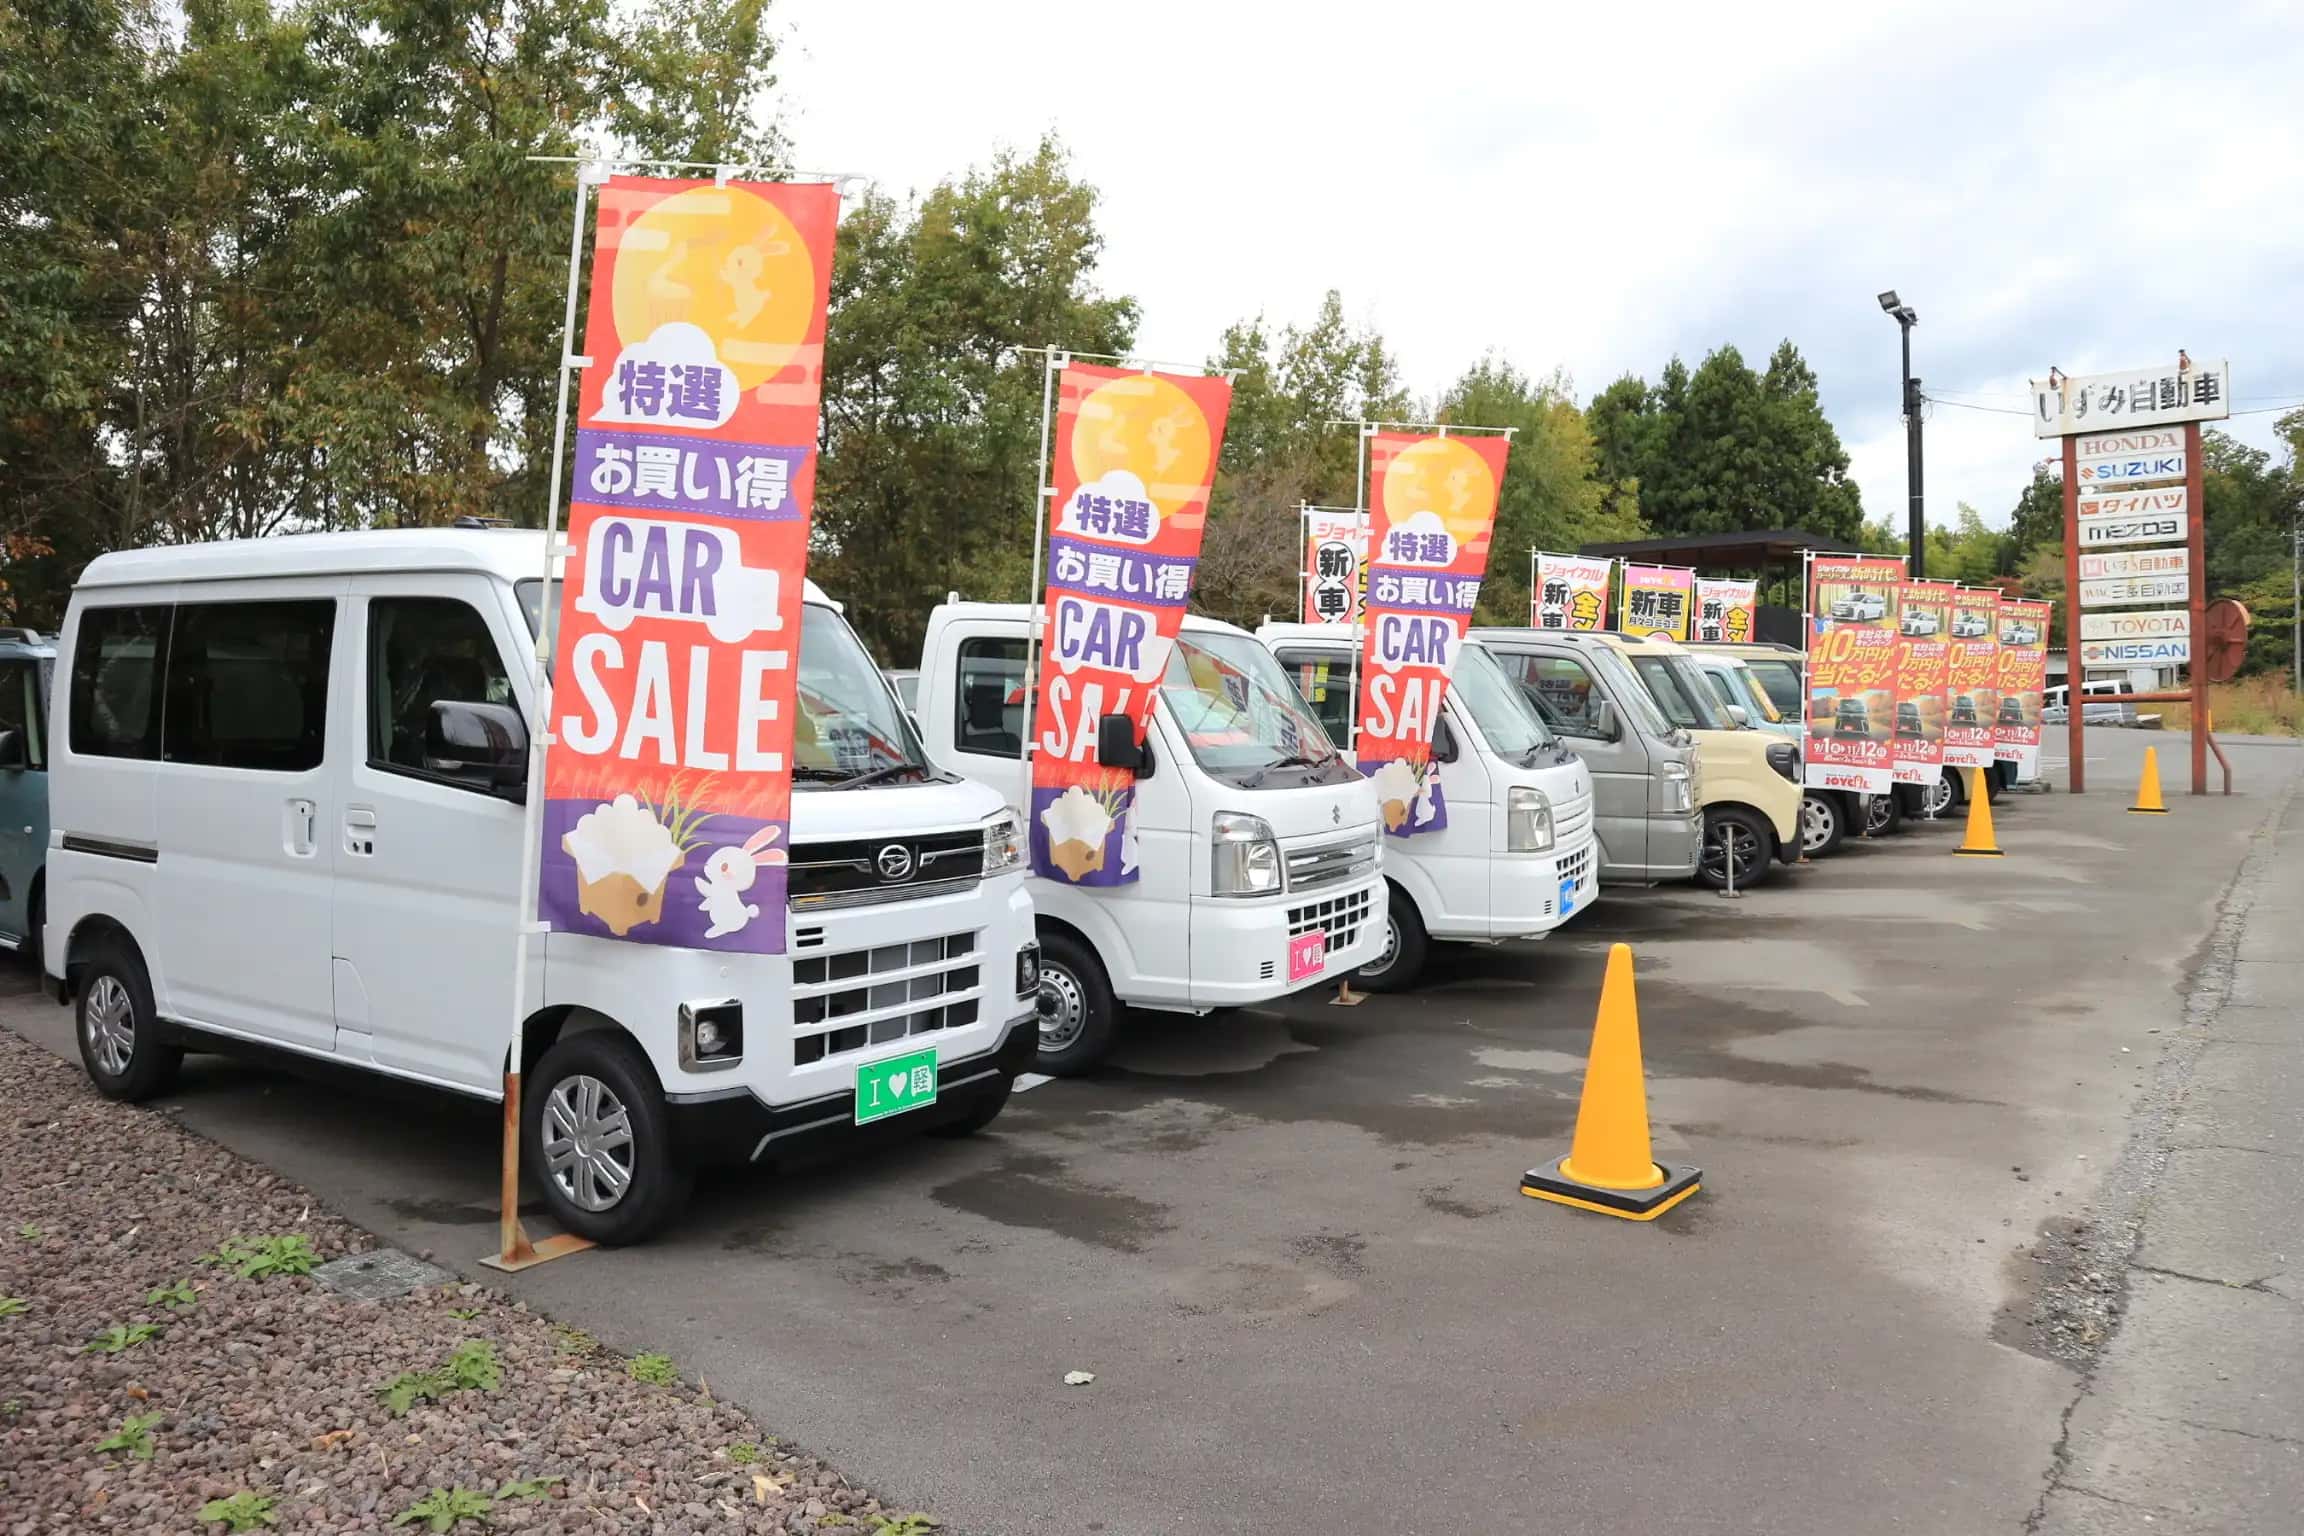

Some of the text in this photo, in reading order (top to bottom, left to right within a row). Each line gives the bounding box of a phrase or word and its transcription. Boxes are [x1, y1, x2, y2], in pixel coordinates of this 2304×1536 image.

[619, 360, 723, 422] 特選
[2039, 372, 2221, 423] いずみ自動車
[2084, 432, 2178, 455] HONDA
[590, 442, 790, 511] お買い得
[2097, 458, 2182, 480] SUZUKI
[1077, 493, 1150, 540] 特選
[599, 522, 724, 617] CAR
[1390, 532, 1449, 563] 特選
[1056, 545, 1190, 600] お買い得
[1376, 574, 1481, 609] お買い得
[1631, 590, 1683, 618] 新車
[2110, 617, 2185, 634] TOYOTA
[1061, 600, 1146, 670] CAR
[1382, 616, 1450, 665] CAR
[2105, 643, 2187, 659] NISSAN
[561, 632, 790, 773] SALE
[869, 1078, 881, 1107] I
